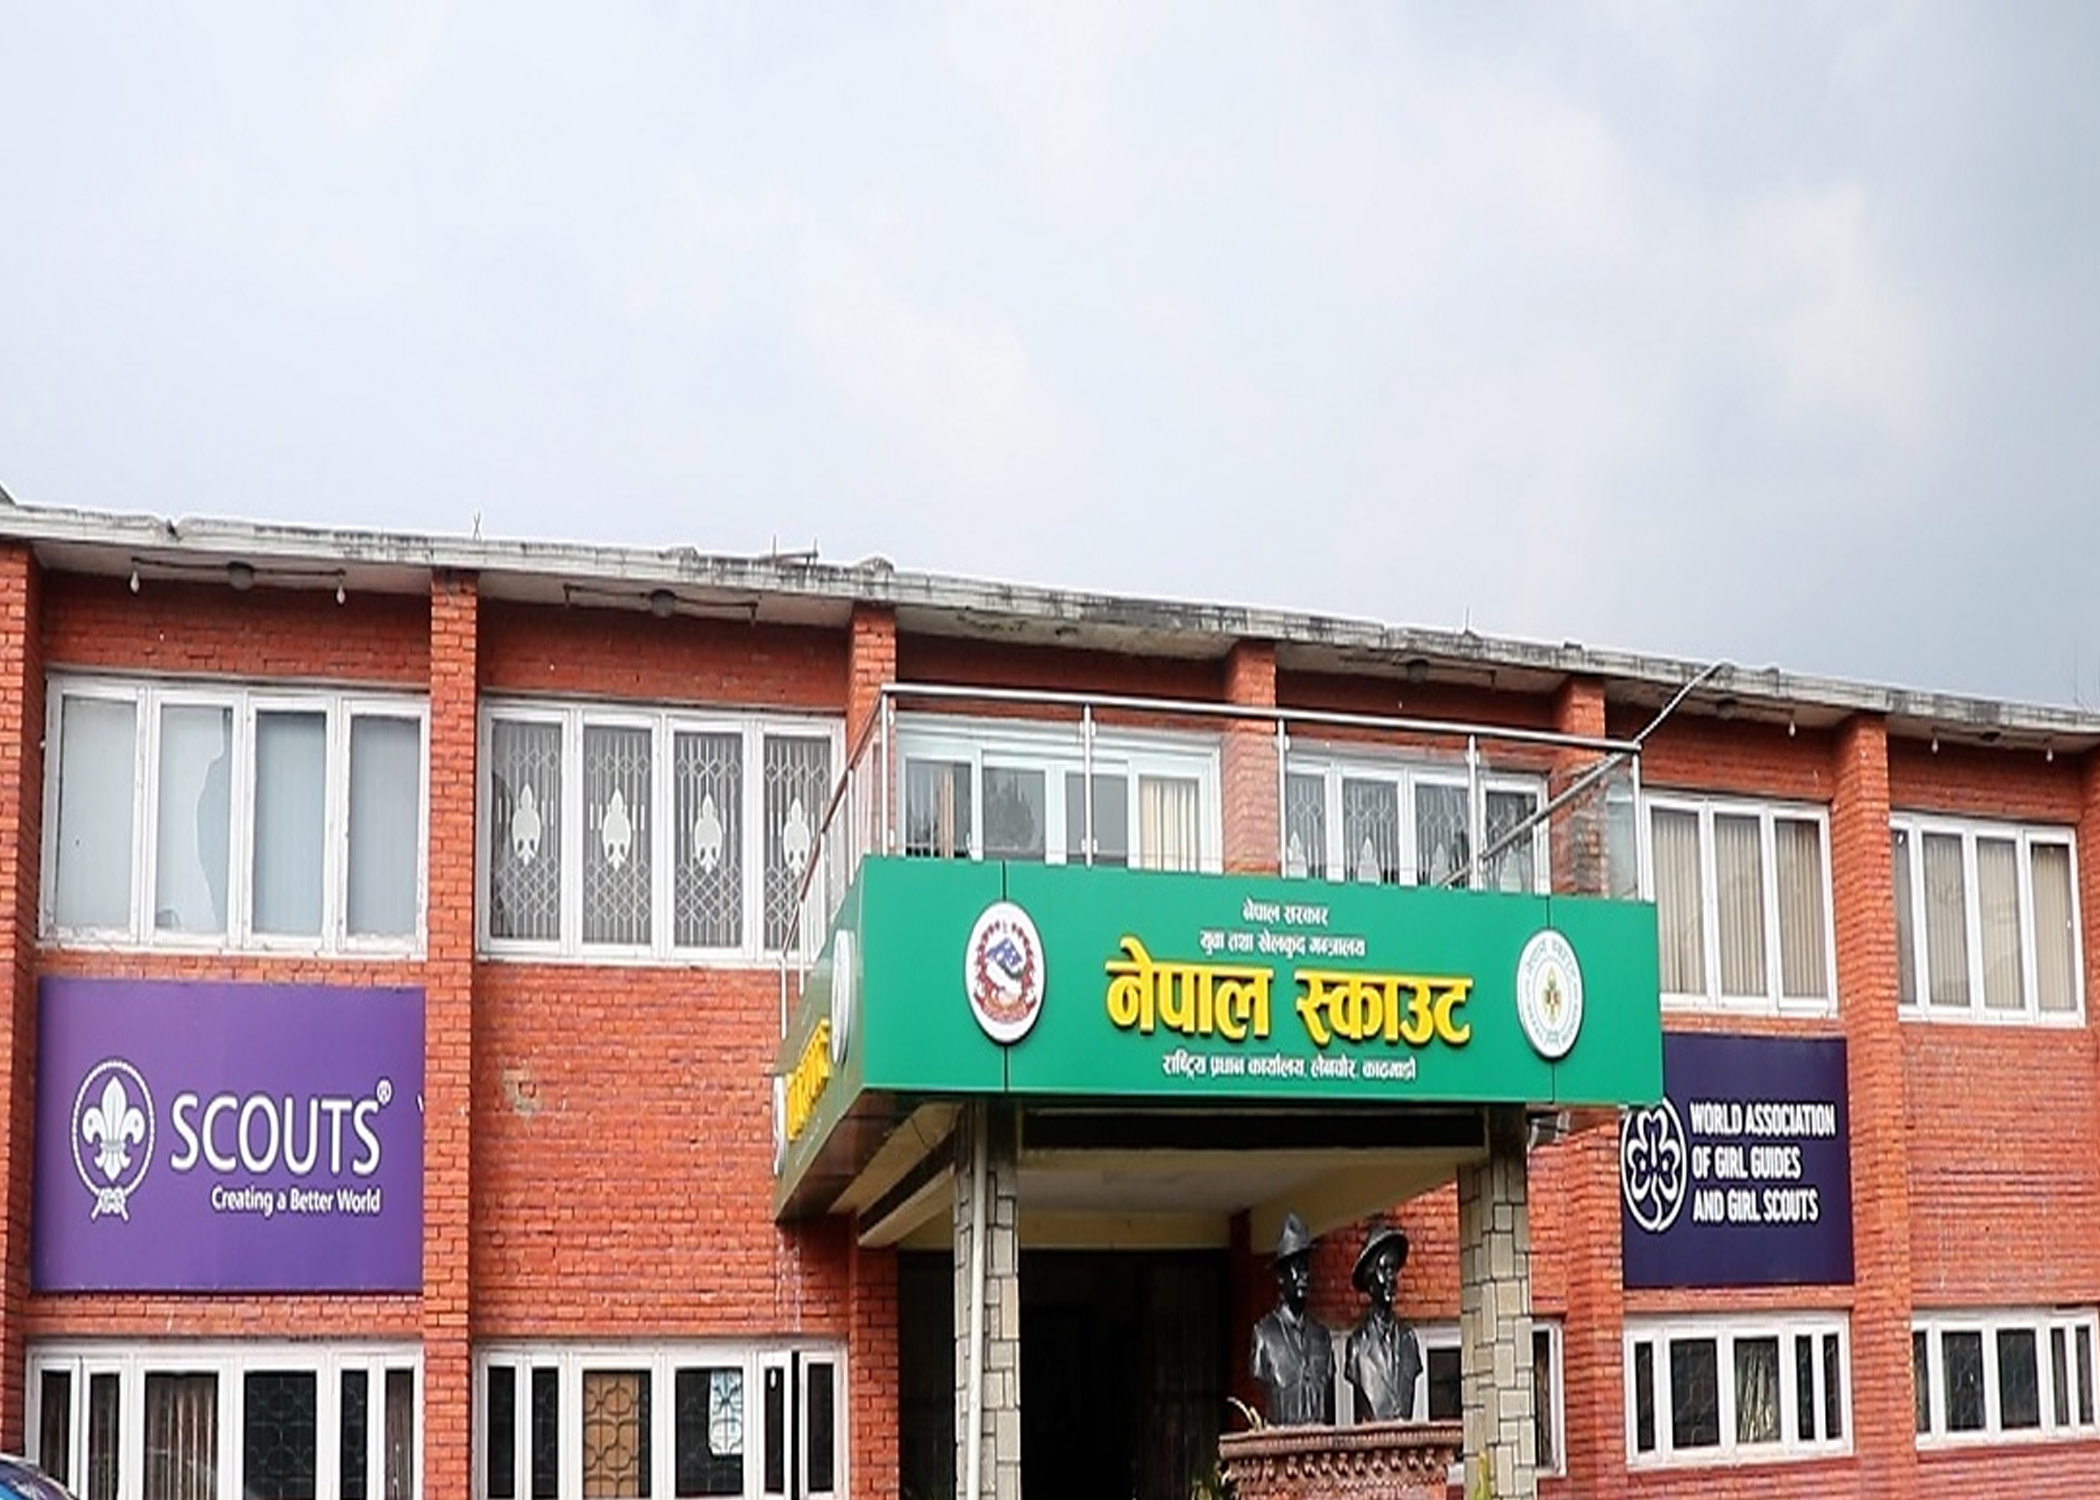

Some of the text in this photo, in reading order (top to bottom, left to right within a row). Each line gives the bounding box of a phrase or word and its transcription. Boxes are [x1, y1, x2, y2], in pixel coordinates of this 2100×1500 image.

[1243, 897, 1329, 926] नेपाल सरकार
[1200, 930, 1225, 956] युवा
[1228, 932, 1253, 953] तथा
[1258, 927, 1305, 959] खेलकुद
[1105, 937, 1274, 1041] नेपाल
[1294, 970, 1473, 1046] स्काउट
[1210, 1056, 1246, 1078] प्रधान
[1690, 1102, 1836, 1137] WORLD ASSOCIATION
[1693, 1146, 1801, 1179] OF GIRL GUIDES
[211, 1184, 382, 1217] Creating a Better World
[1693, 1189, 1819, 1222] AND GIRL SCOUTS
